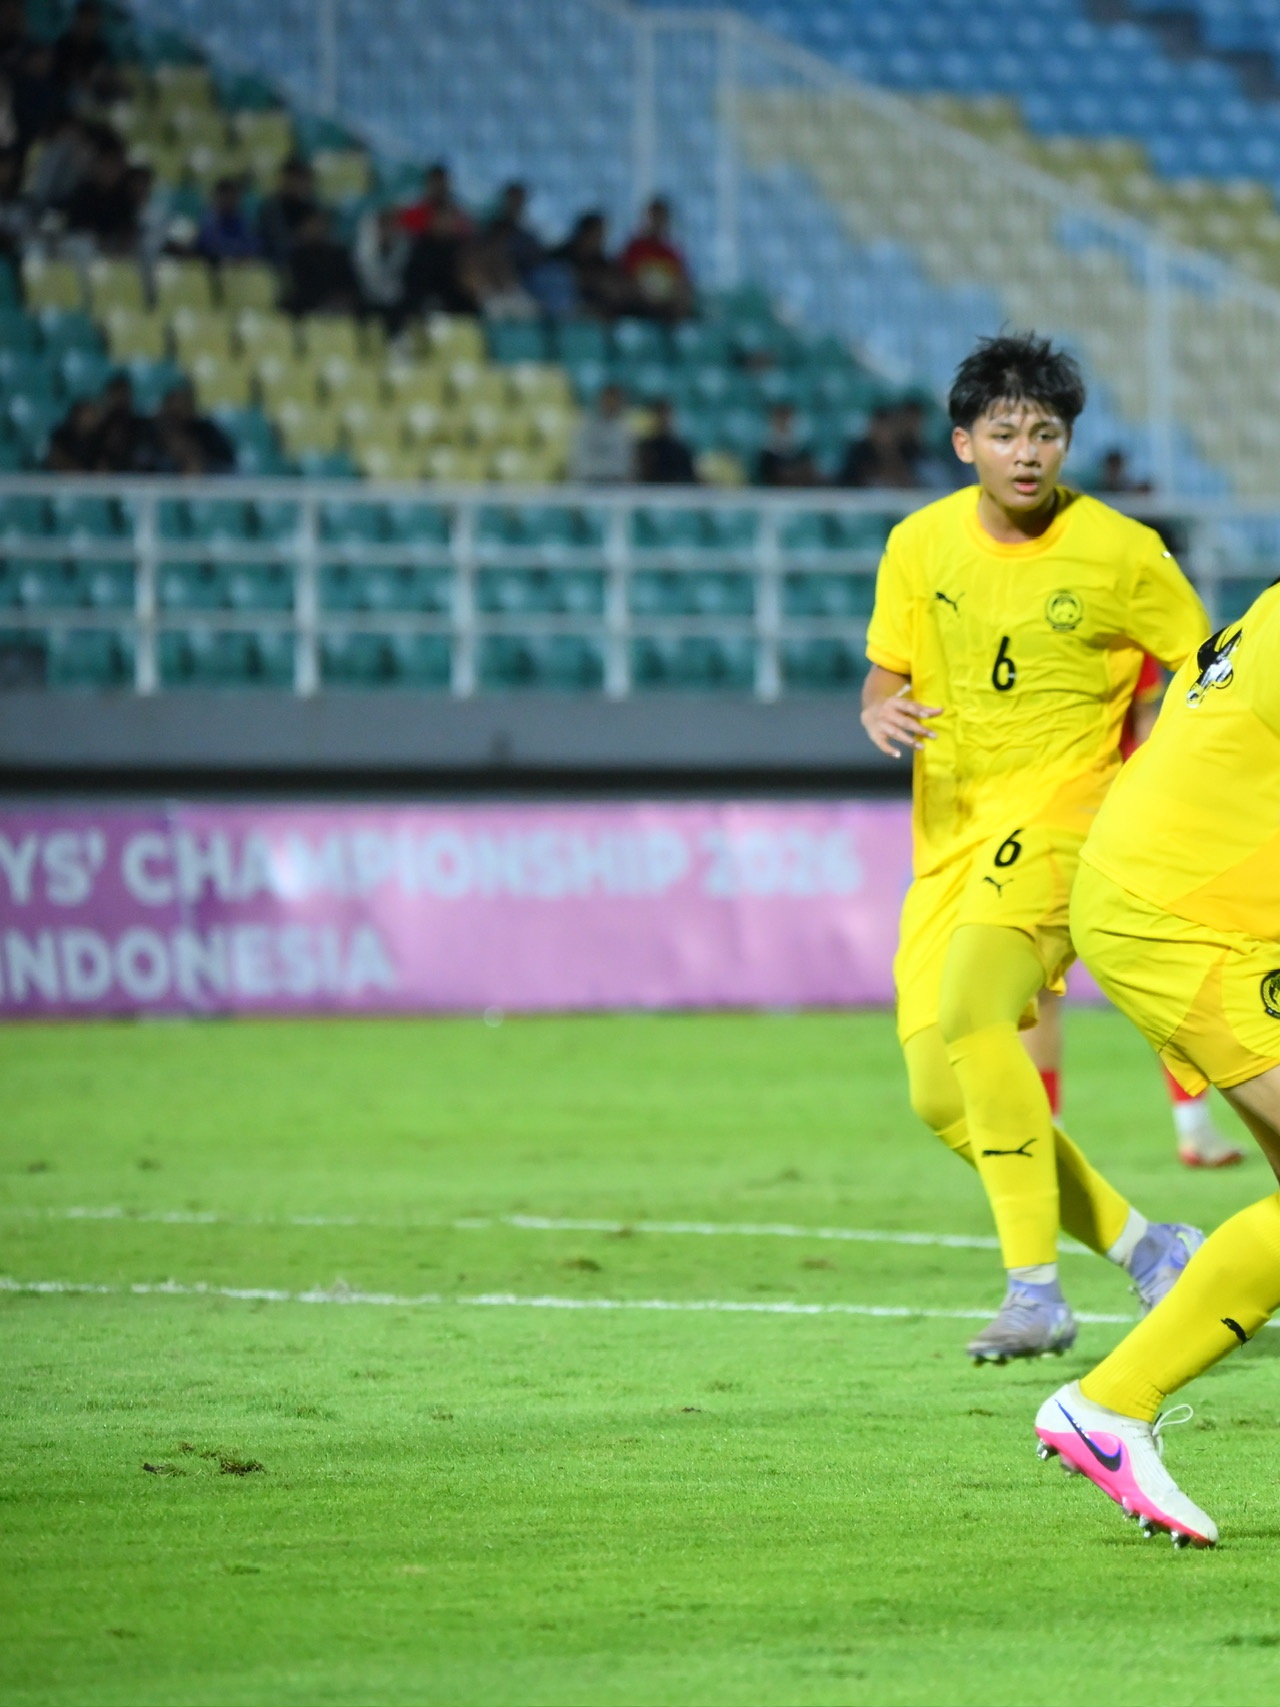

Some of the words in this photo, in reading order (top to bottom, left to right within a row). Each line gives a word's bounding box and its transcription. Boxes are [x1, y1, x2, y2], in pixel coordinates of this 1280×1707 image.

[992, 635, 1016, 691] 6
[121, 826, 690, 905] CHAMPIONSHIP
[701, 828, 863, 897] 2026
[994, 828, 1023, 867] 6
[0, 924, 397, 1003] NDONESIA
